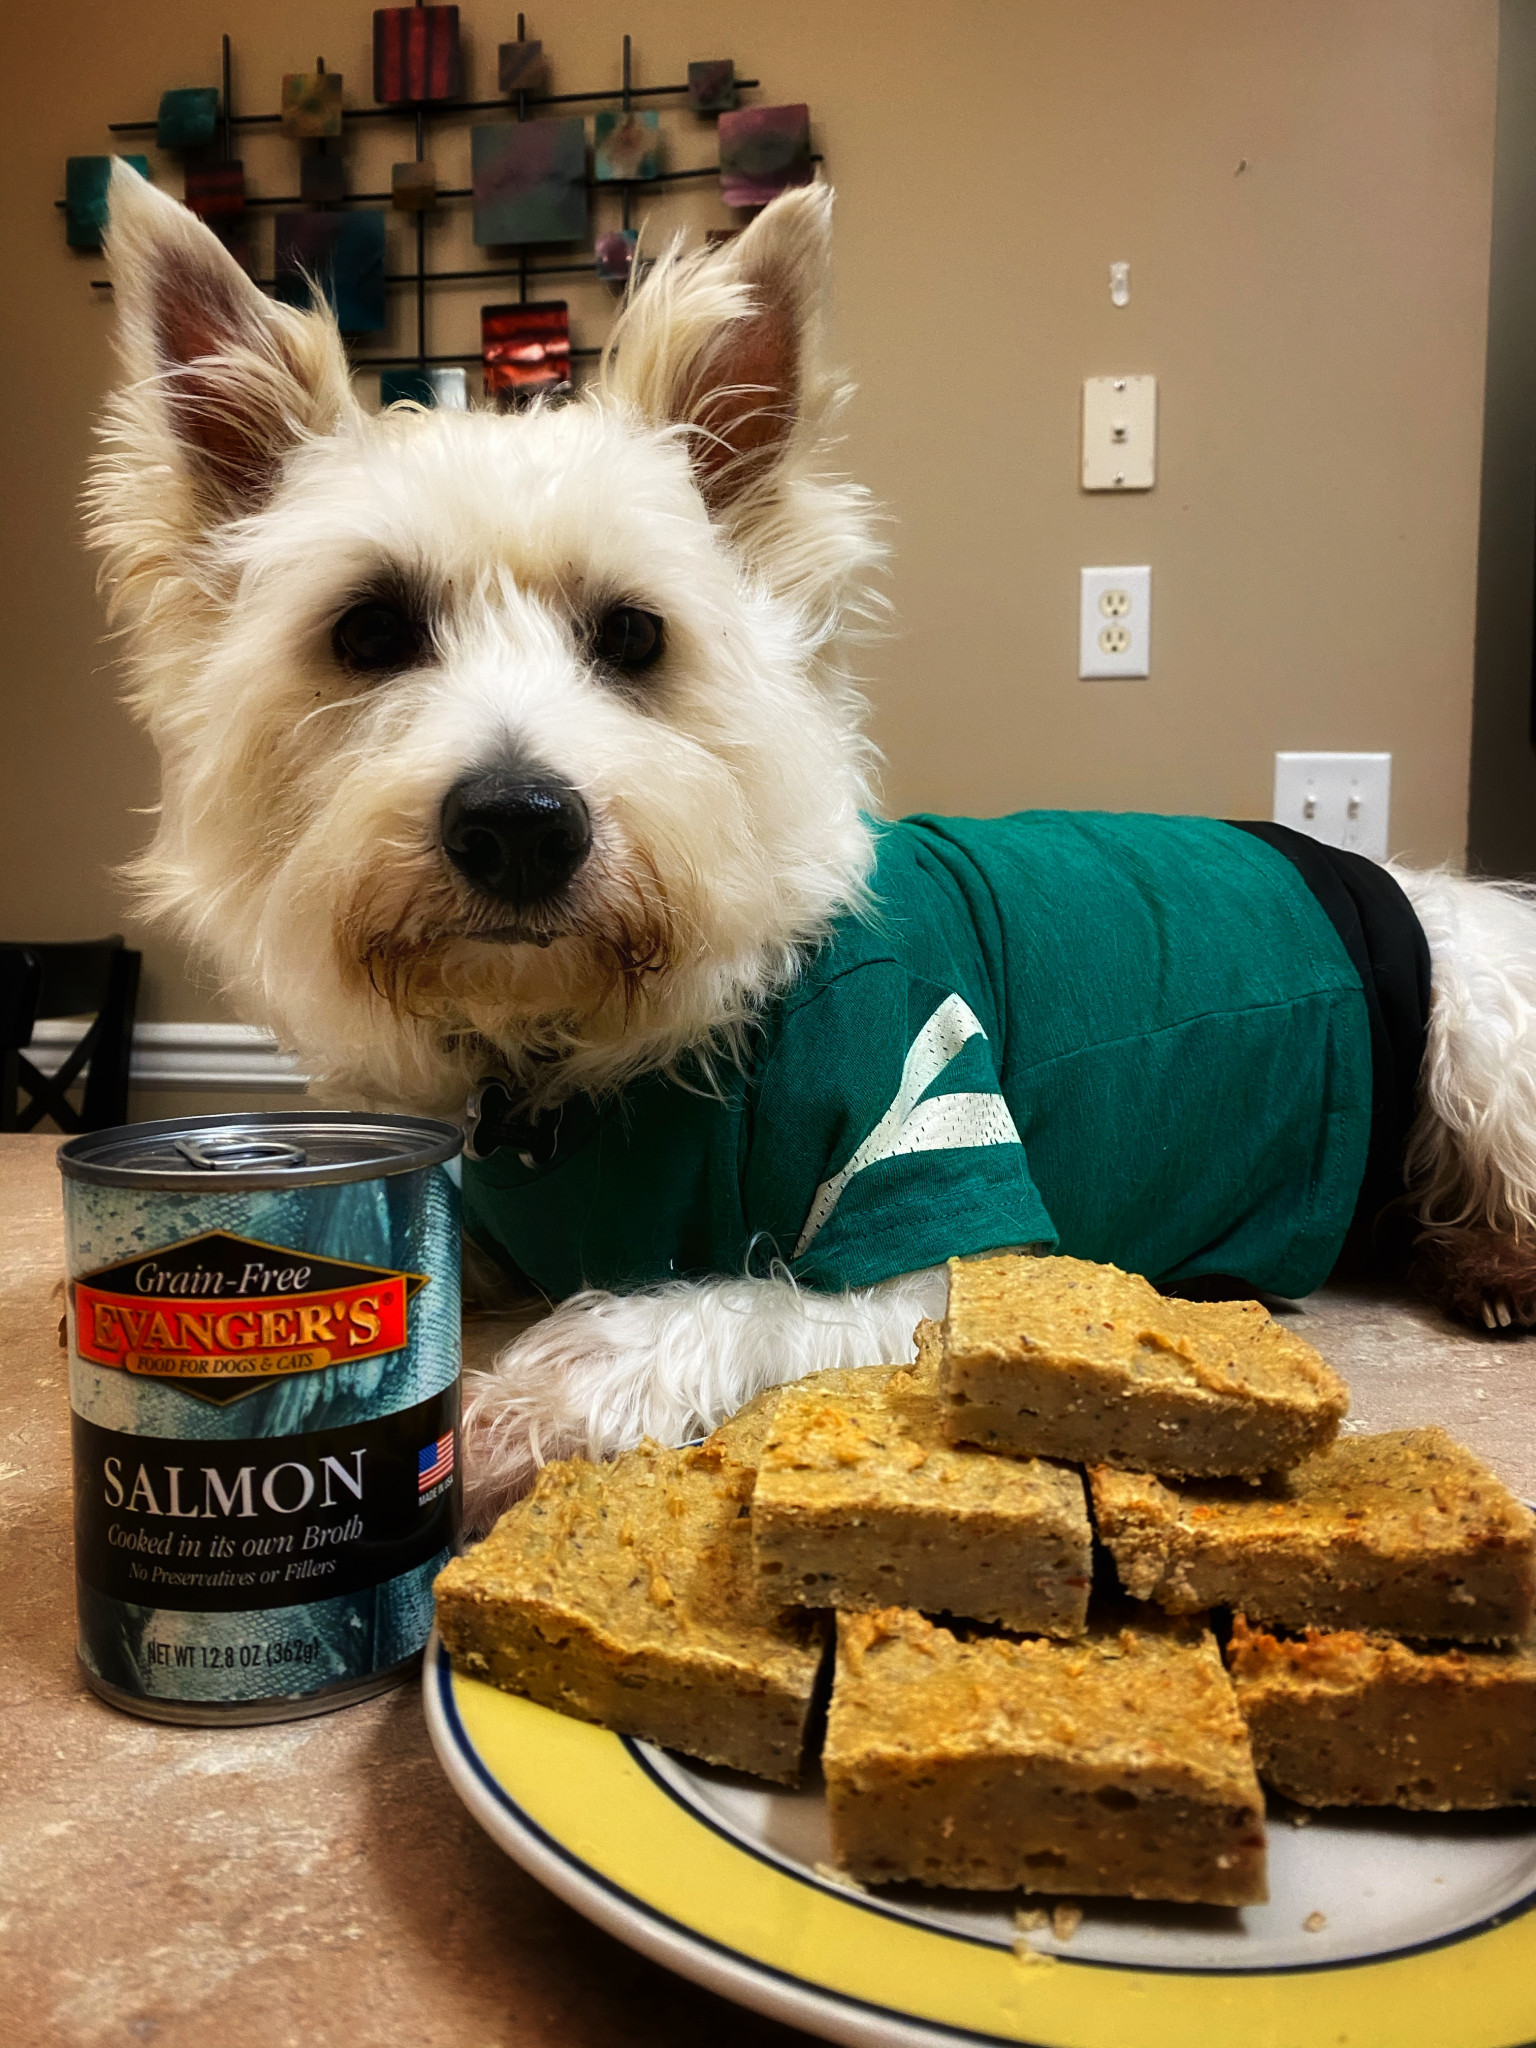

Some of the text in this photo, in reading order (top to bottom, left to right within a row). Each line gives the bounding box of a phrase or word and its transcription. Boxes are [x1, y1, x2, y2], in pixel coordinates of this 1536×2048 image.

[136, 1264, 311, 1294] Grain-Free
[137, 1352, 313, 1373] FOOD FOR DOGS & CATS
[104, 1449, 367, 1518] SALMON
[109, 1514, 363, 1558] Cooked in its own Broth
[128, 1559, 336, 1586] No Preservatives or Fillers
[147, 1641, 171, 1665] NET
[175, 1645, 196, 1667] WT
[202, 1646, 233, 1668] 12.8
[240, 1644, 260, 1667] OZ
